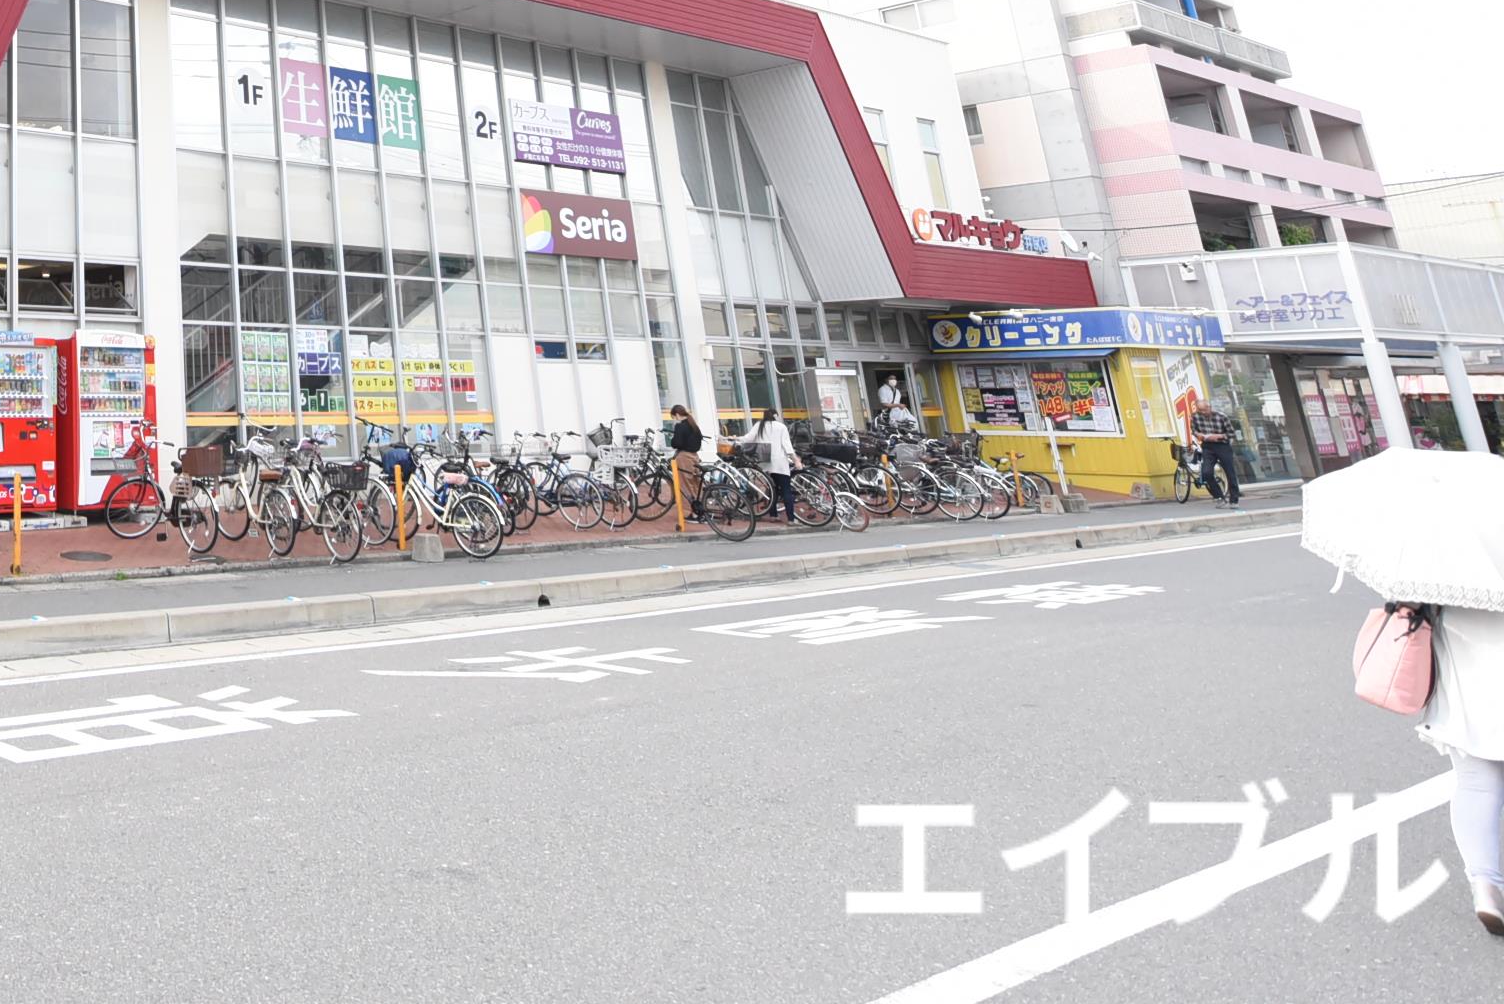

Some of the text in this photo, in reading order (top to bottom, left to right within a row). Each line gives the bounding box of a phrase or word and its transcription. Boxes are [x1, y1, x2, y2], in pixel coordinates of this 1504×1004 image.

[236, 74, 264, 106] 1F
[280, 71, 419, 142] 生鮮館
[474, 110, 498, 140] 2F
[576, 111, 612, 134] Curves
[559, 207, 628, 244] Seria
[930, 209, 1022, 250] マルキョウ
[1239, 307, 1345, 325] 美容室サカエ
[965, 322, 1082, 348] クリーニング
